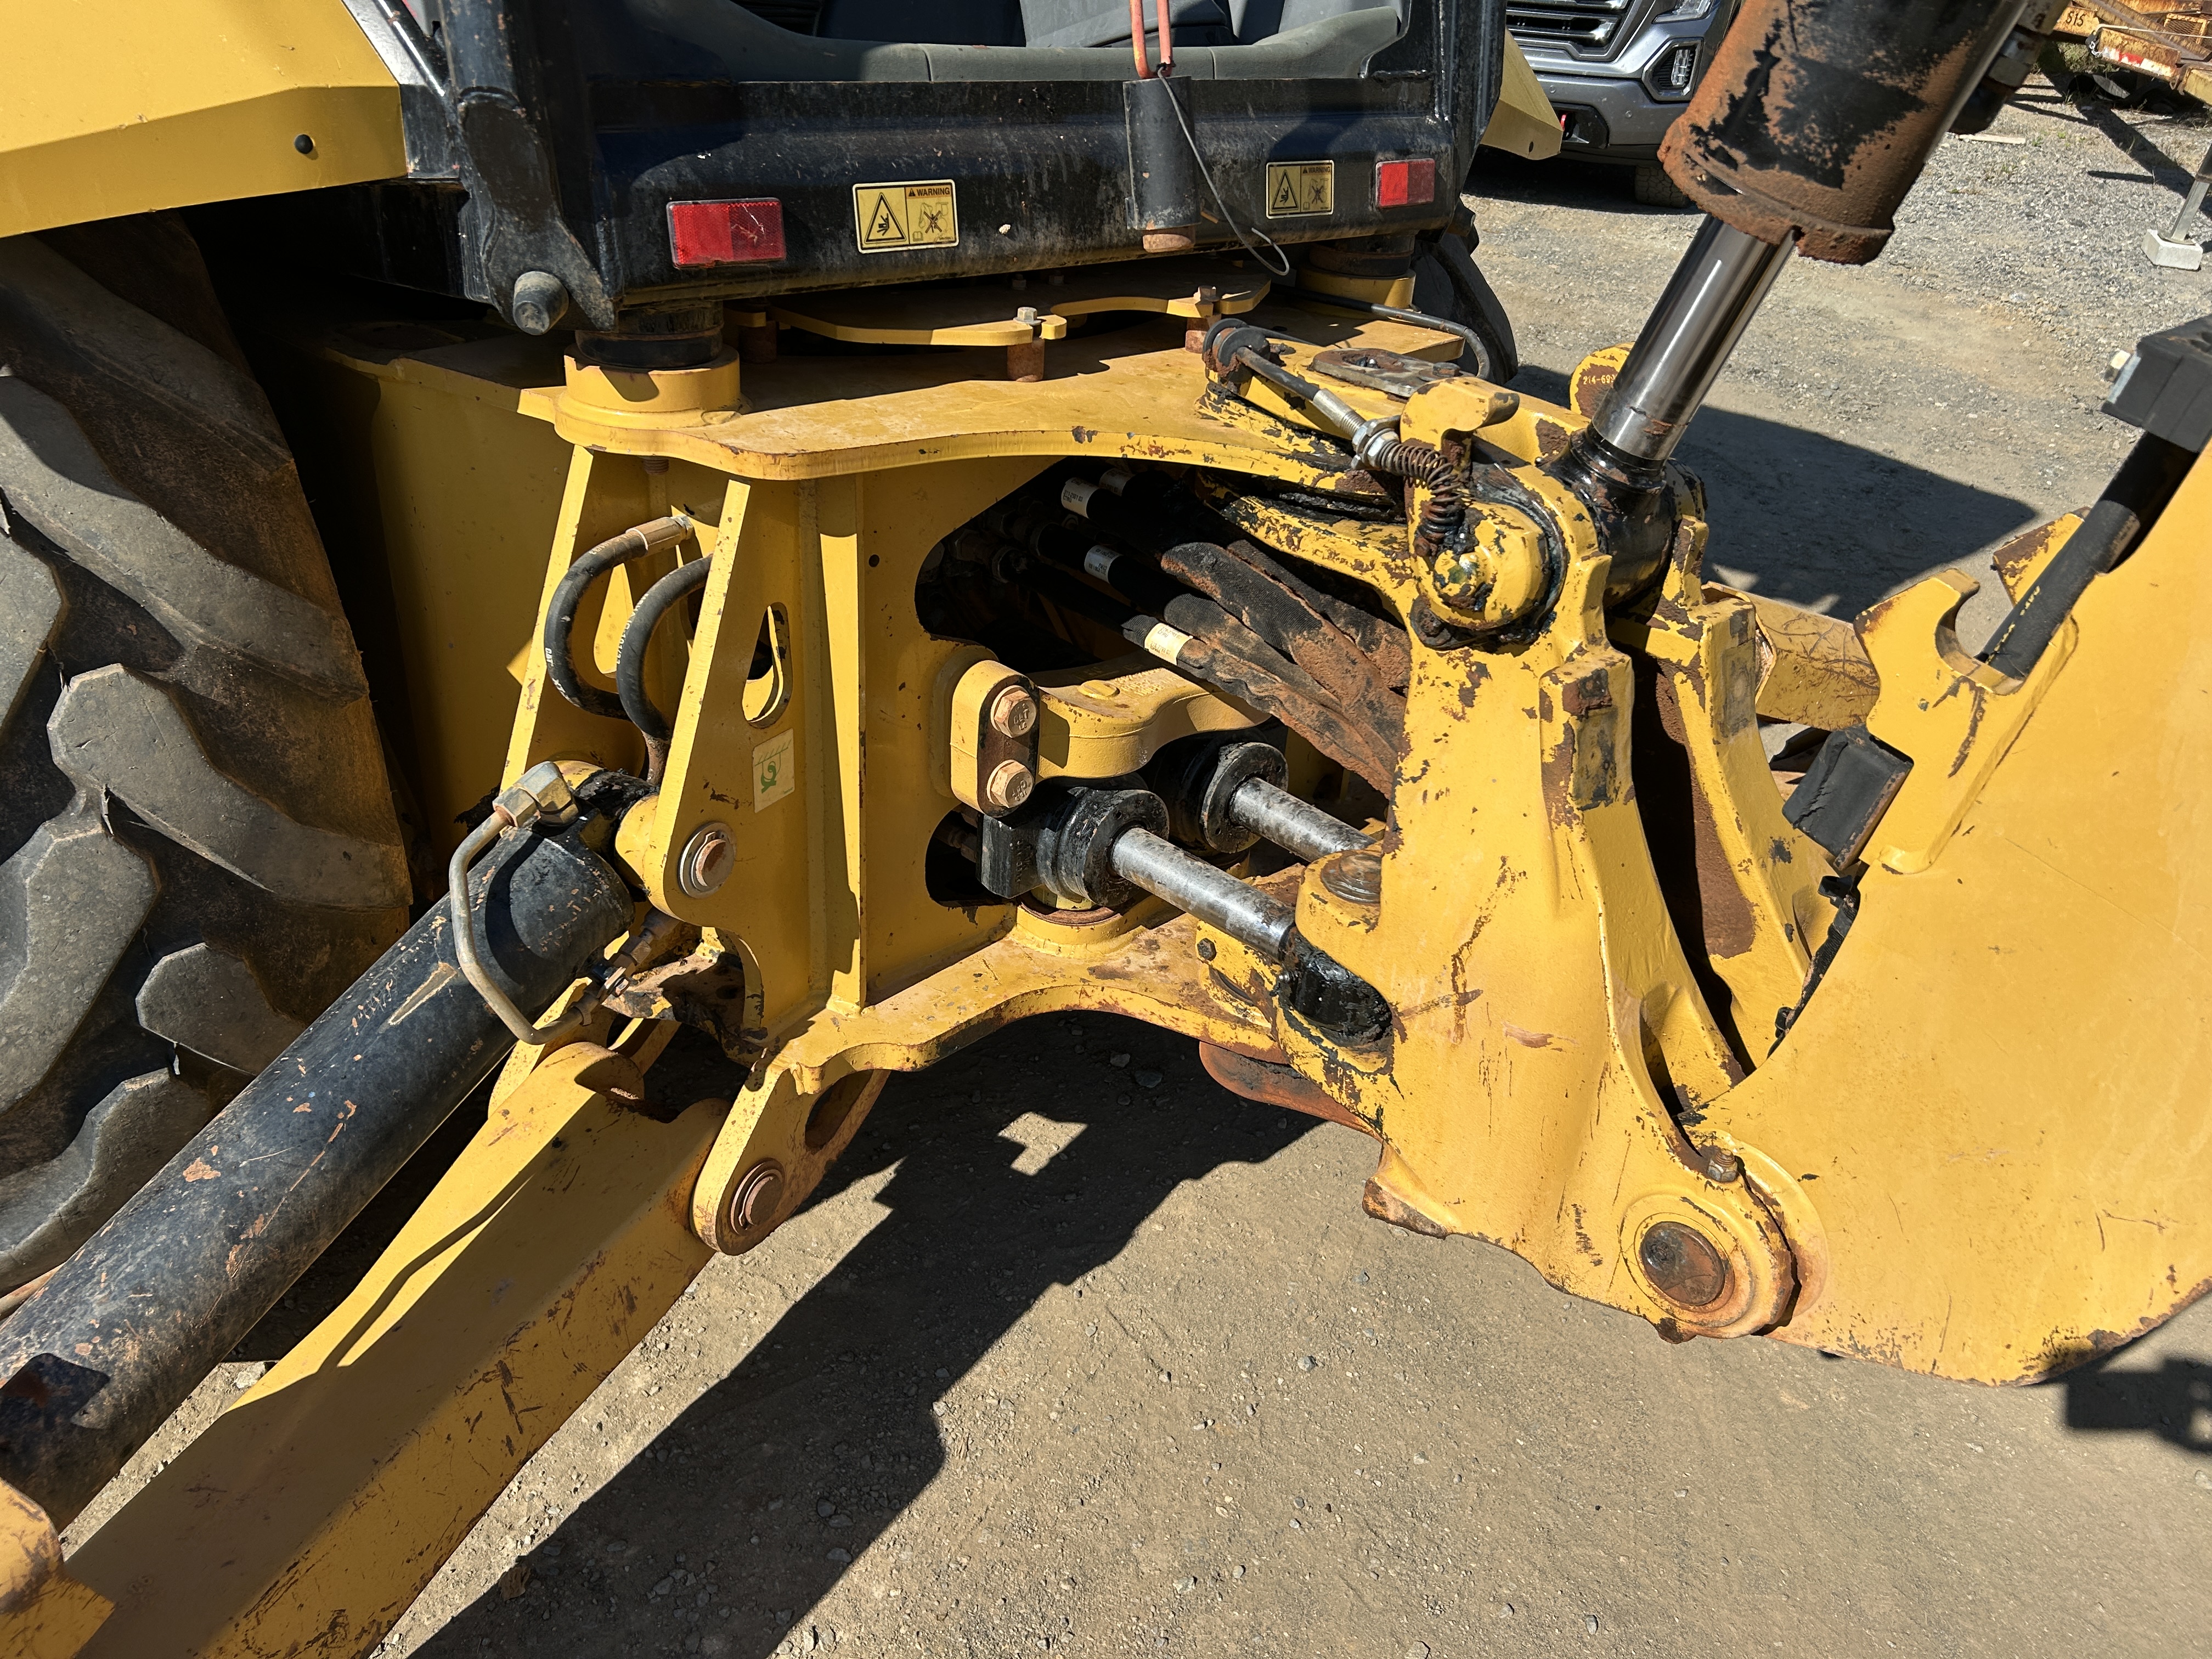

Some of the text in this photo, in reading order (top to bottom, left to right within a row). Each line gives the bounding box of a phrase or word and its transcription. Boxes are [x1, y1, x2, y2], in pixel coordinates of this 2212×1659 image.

[2065, 10, 2085, 27] 515
[917, 187, 950, 196] WARNING
[545, 647, 554, 664] CAT
[1013, 708, 1030, 724] CAT
